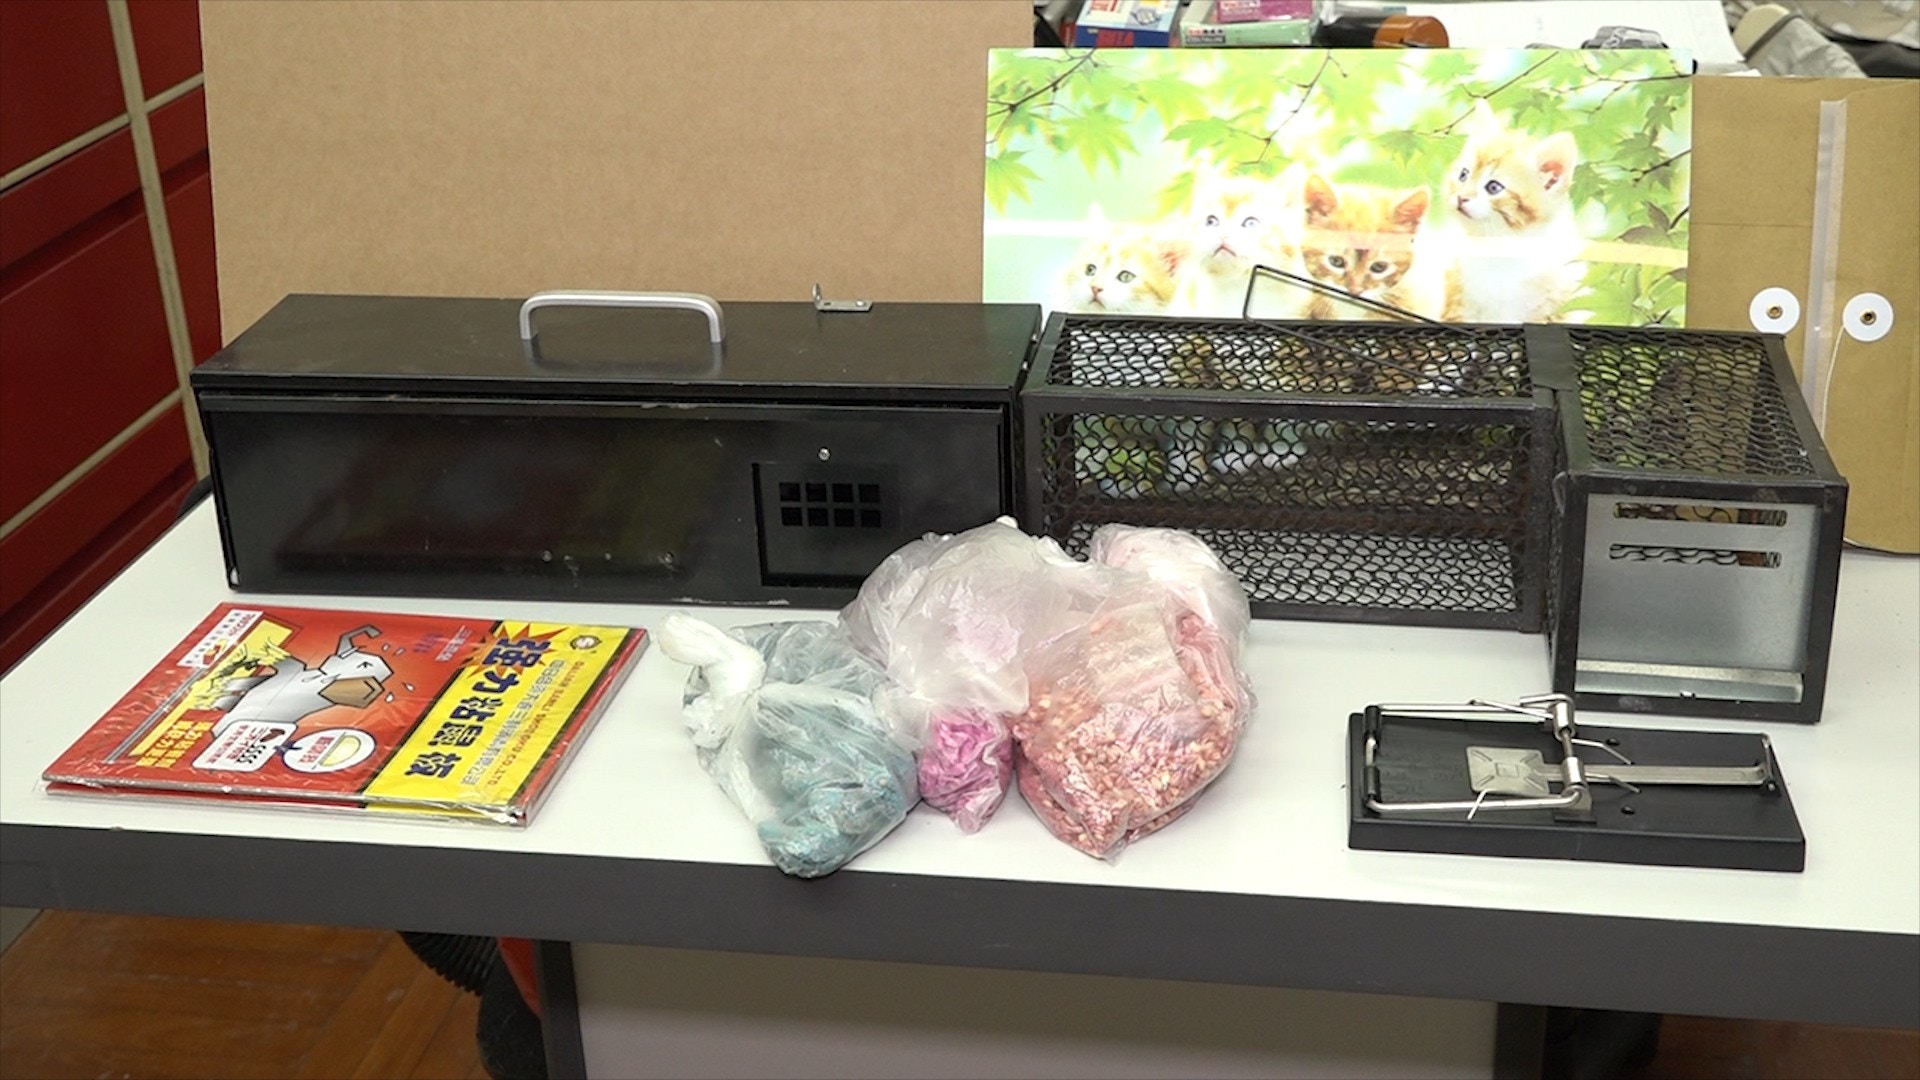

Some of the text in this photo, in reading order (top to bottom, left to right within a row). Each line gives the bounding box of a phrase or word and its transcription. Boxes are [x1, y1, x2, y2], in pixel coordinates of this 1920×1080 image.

[404, 638, 551, 777] 强力粘鼠板
